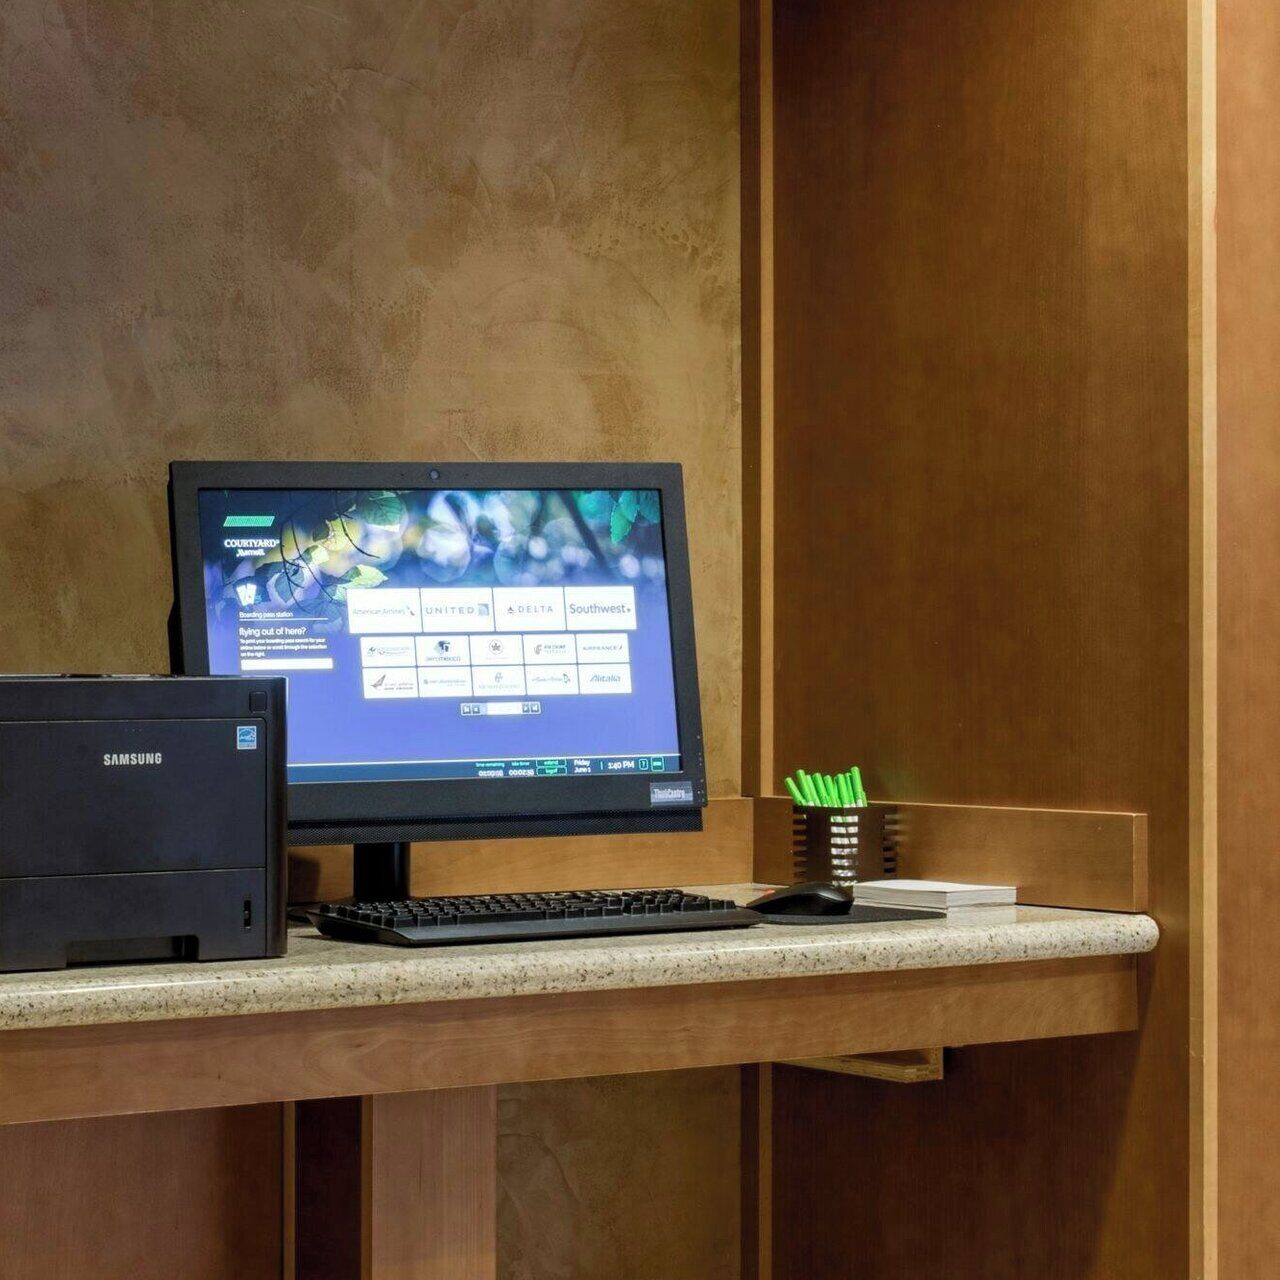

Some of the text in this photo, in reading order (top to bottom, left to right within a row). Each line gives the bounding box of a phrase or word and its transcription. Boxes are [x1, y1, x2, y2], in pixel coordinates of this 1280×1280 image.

[425, 606, 475, 615] UNITED
[518, 605, 554, 613] DELTA
[569, 603, 626, 614] Southwest
[239, 627, 261, 638] flying
[261, 628, 275, 636] out
[103, 752, 162, 766] SAMSUNG
